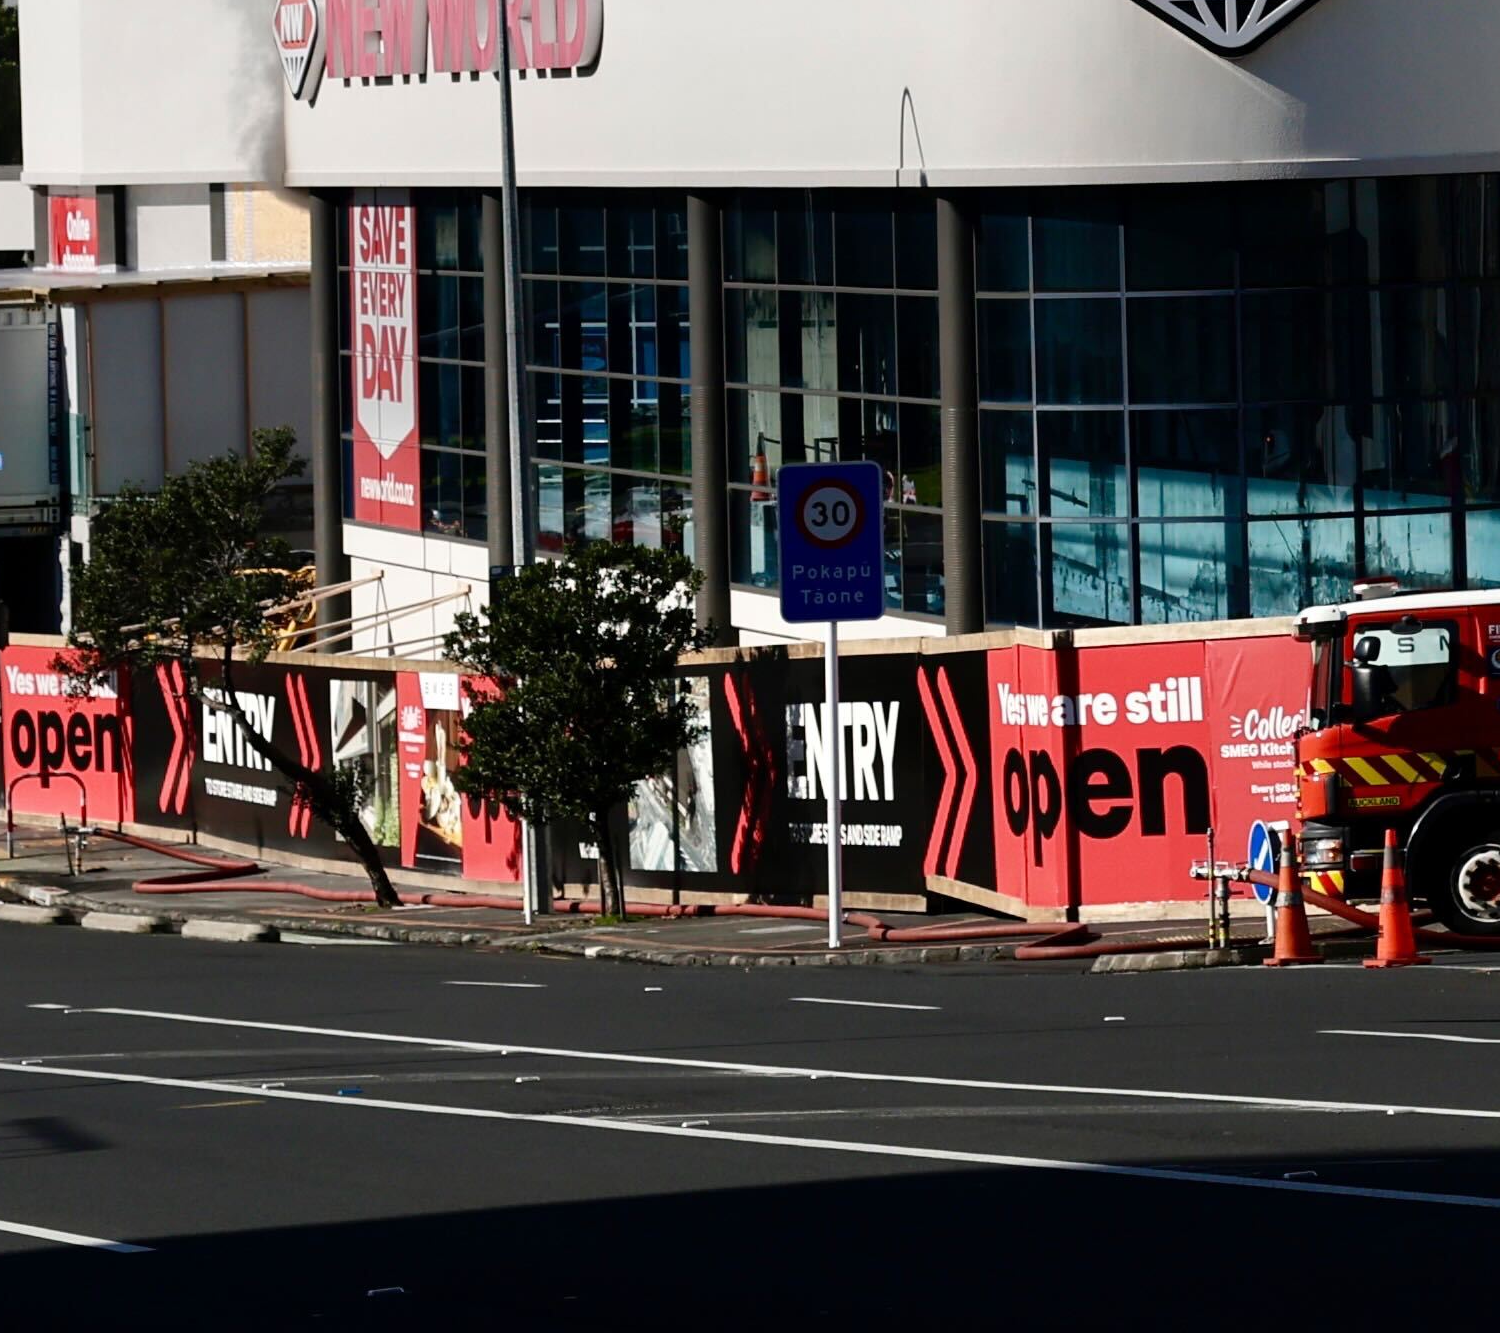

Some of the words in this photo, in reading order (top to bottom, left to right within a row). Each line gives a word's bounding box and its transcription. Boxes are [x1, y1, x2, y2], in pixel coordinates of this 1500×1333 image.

[281, 4, 307, 43] NW
[66, 210, 90, 241] Online
[359, 206, 406, 265] SAVE
[360, 272, 406, 319] EVERY
[361, 323, 408, 403] DAY
[811, 500, 850, 527] 30
[5, 666, 34, 695] Yes
[35, 673, 59, 695] we
[997, 683, 1025, 726] Yes
[1025, 693, 1048, 727] we
[1050, 692, 1117, 727] are
[1125, 676, 1203, 725] still
[11, 708, 122, 789] open
[202, 687, 276, 771] ENTRY
[786, 701, 900, 801] ENTRY
[1220, 744, 1260, 759] SMEG
[1003, 744, 1211, 867] open
[1251, 784, 1273, 795] Every
[1275, 784, 1291, 794] $20
[1349, 796, 1400, 807] AUCKLAND
